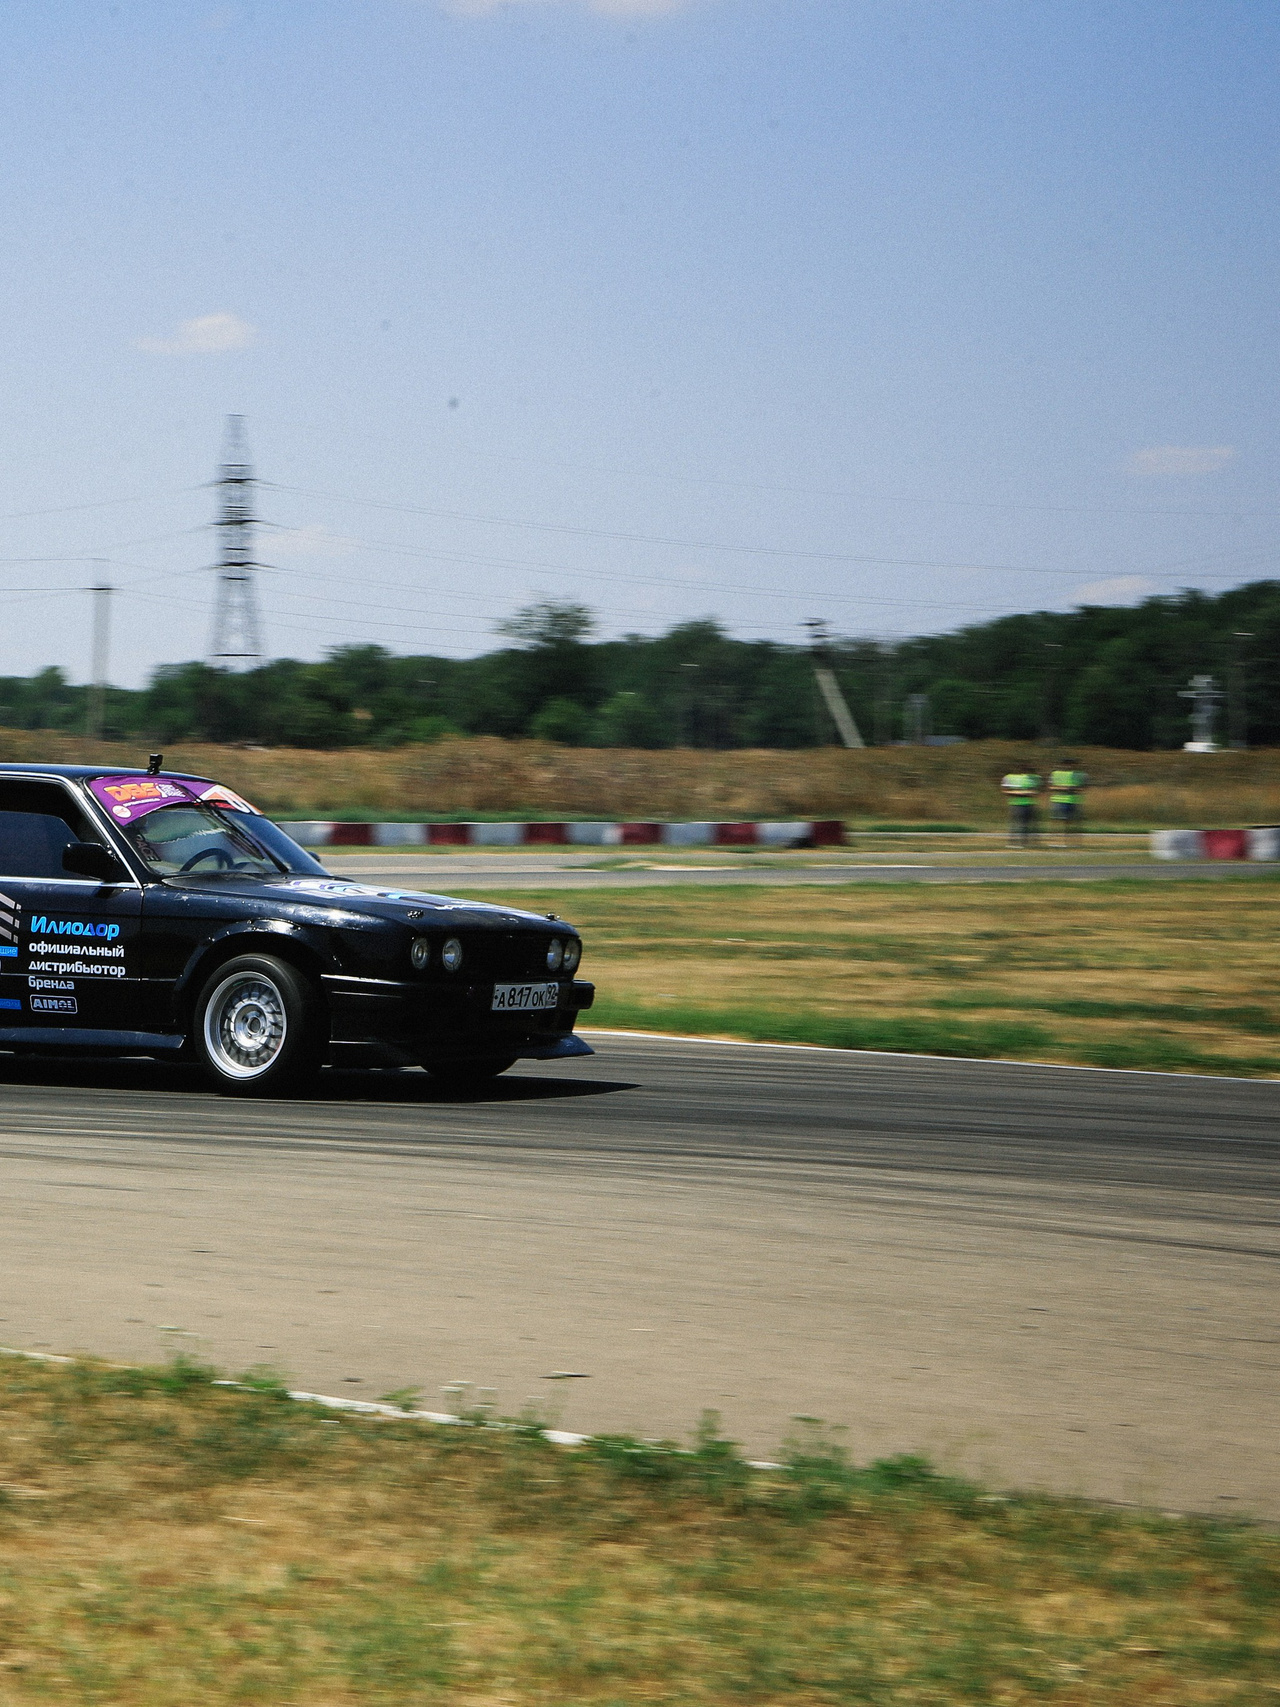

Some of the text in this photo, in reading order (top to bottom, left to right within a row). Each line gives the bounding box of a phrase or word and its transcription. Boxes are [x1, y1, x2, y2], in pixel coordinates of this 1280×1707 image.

[30, 915, 120, 941] Илиодор
[28, 940, 125, 958] официальный
[28, 960, 126, 978] дистрибьютор
[28, 975, 75, 990] бренда
